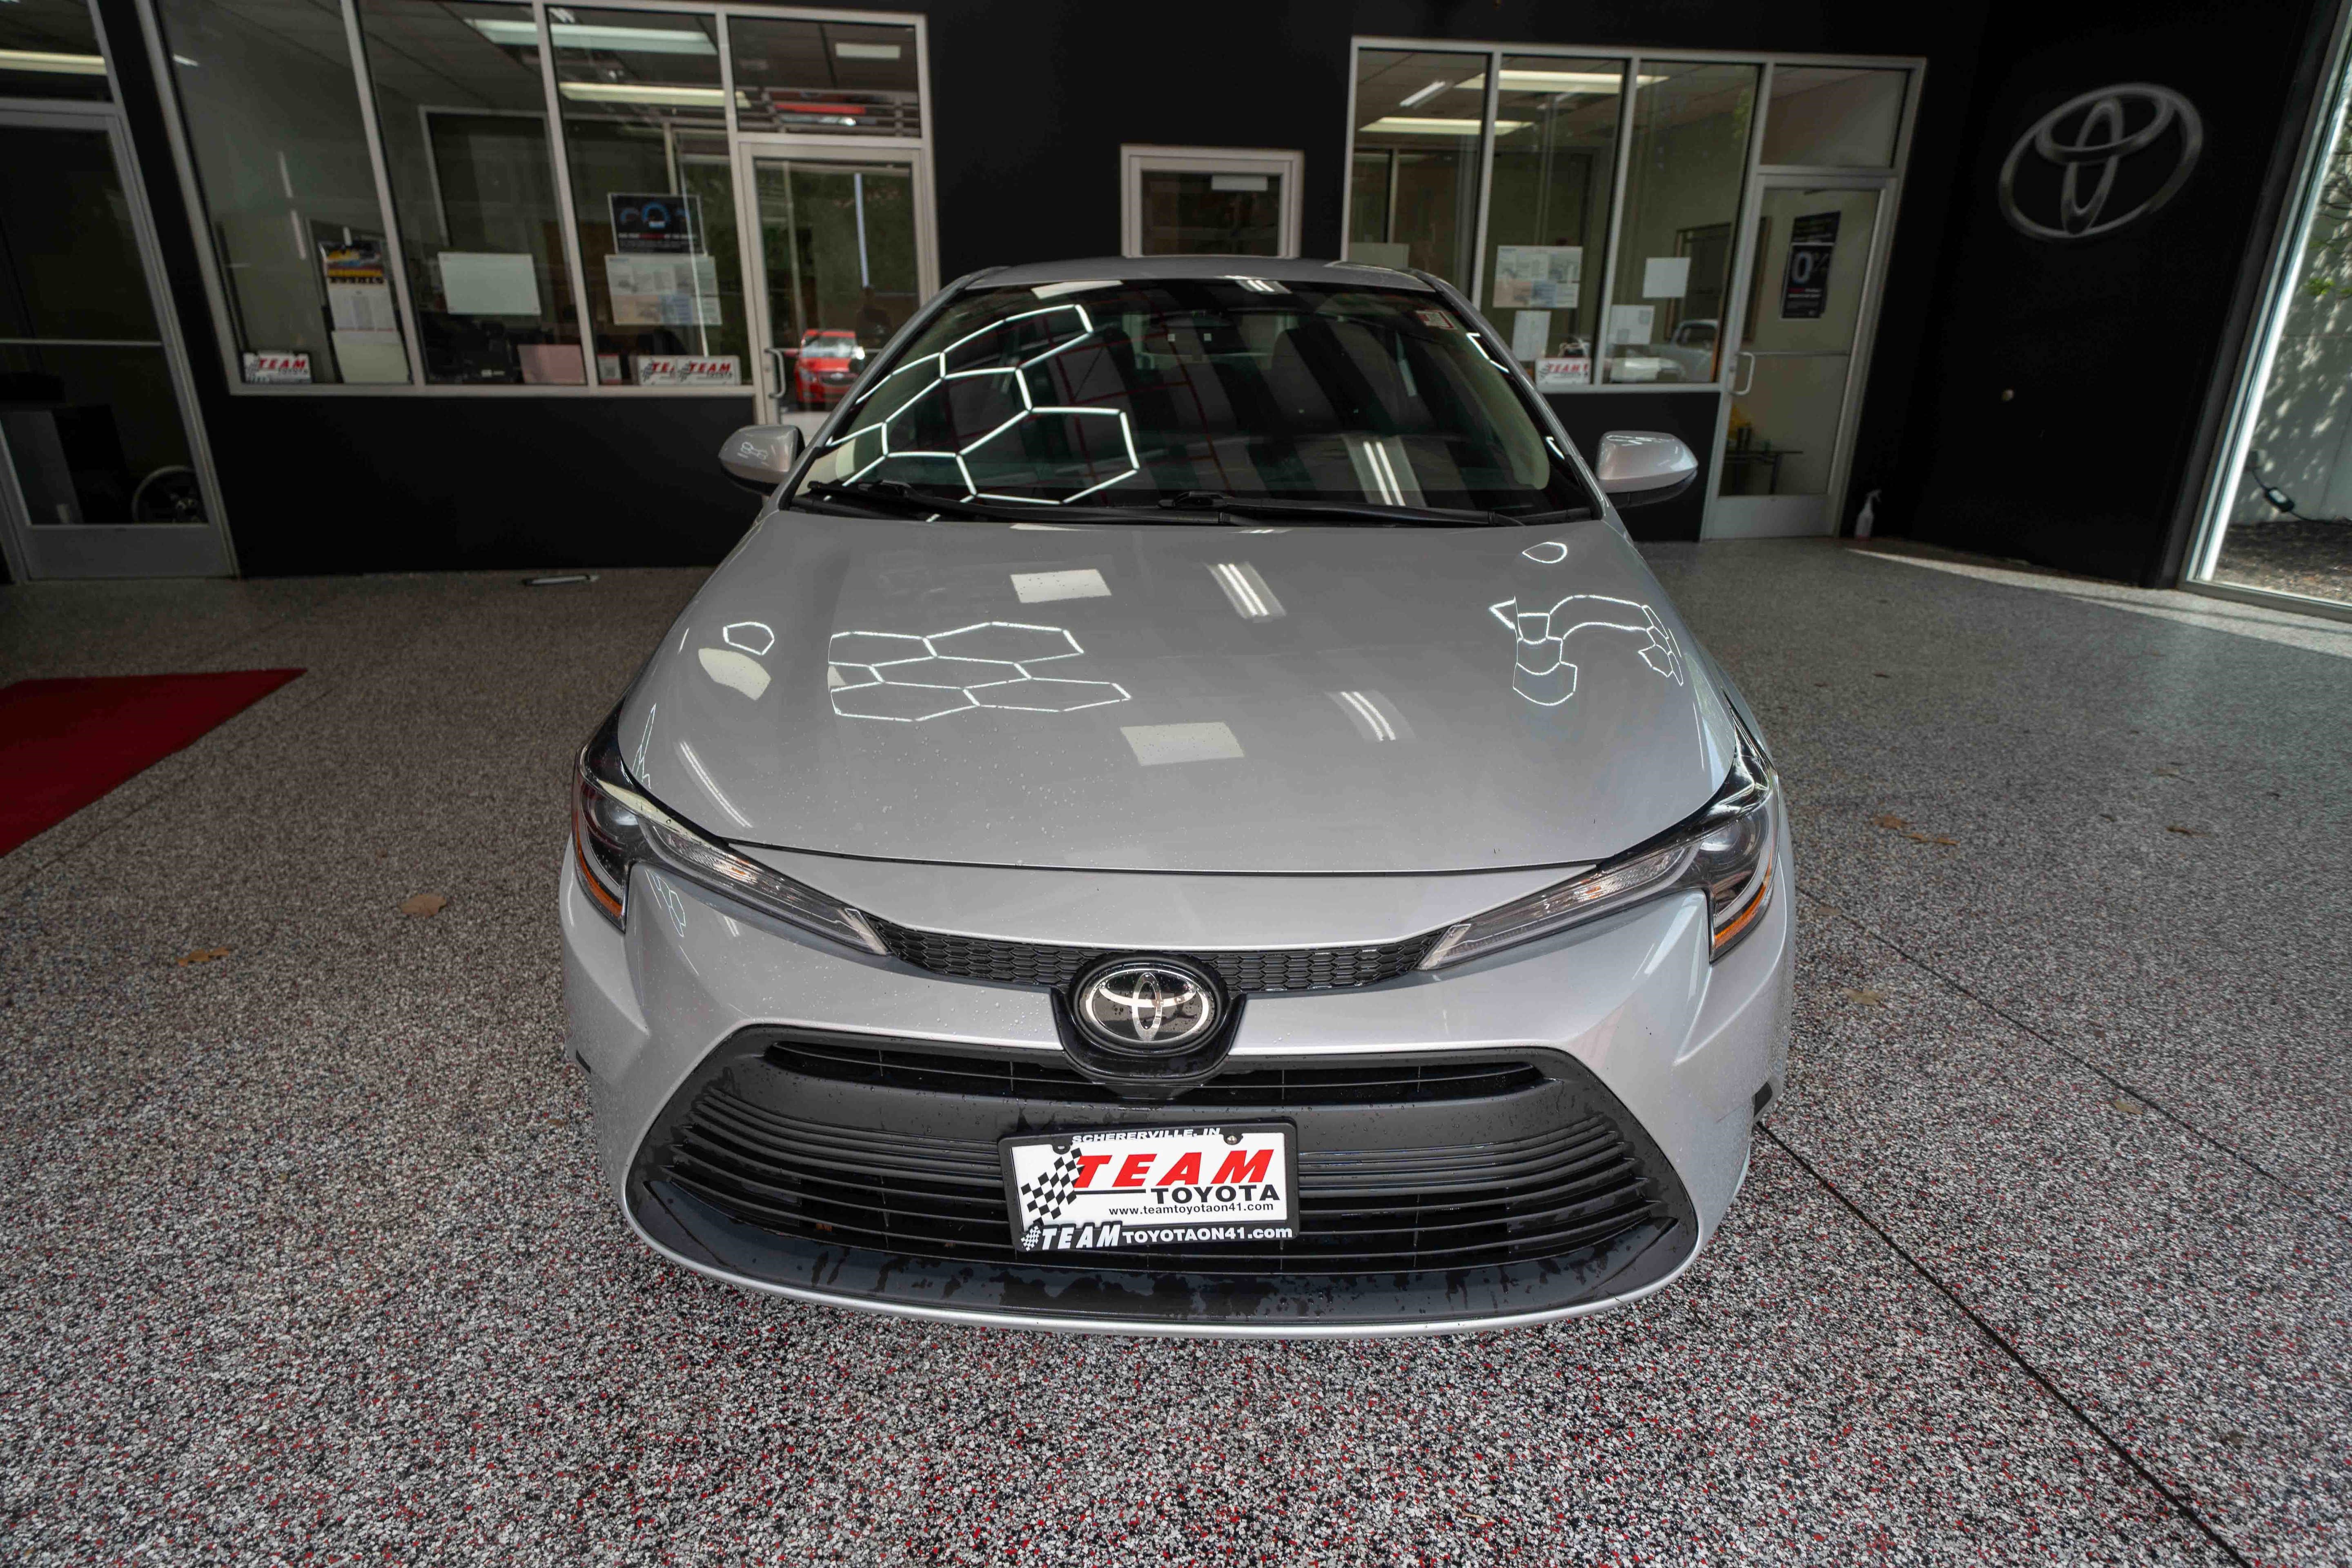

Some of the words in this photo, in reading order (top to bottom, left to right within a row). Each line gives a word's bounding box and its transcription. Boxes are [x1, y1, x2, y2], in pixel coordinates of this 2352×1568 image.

[258, 358, 306, 370] TEAM
[653, 362, 675, 373] TE
[688, 362, 731, 373] TEAM
[1548, 363, 1580, 372] TEAM
[1202, 1127, 1221, 1136] IN
[1074, 1149, 1274, 1188] TEAM
[1151, 1184, 1280, 1204] TOYOTA
[1109, 1202, 1274, 1216] www.teamtoyotaon41.com
[1042, 1224, 1121, 1250] TEAM
[1123, 1227, 1292, 1244] TOYOTAON41.com
